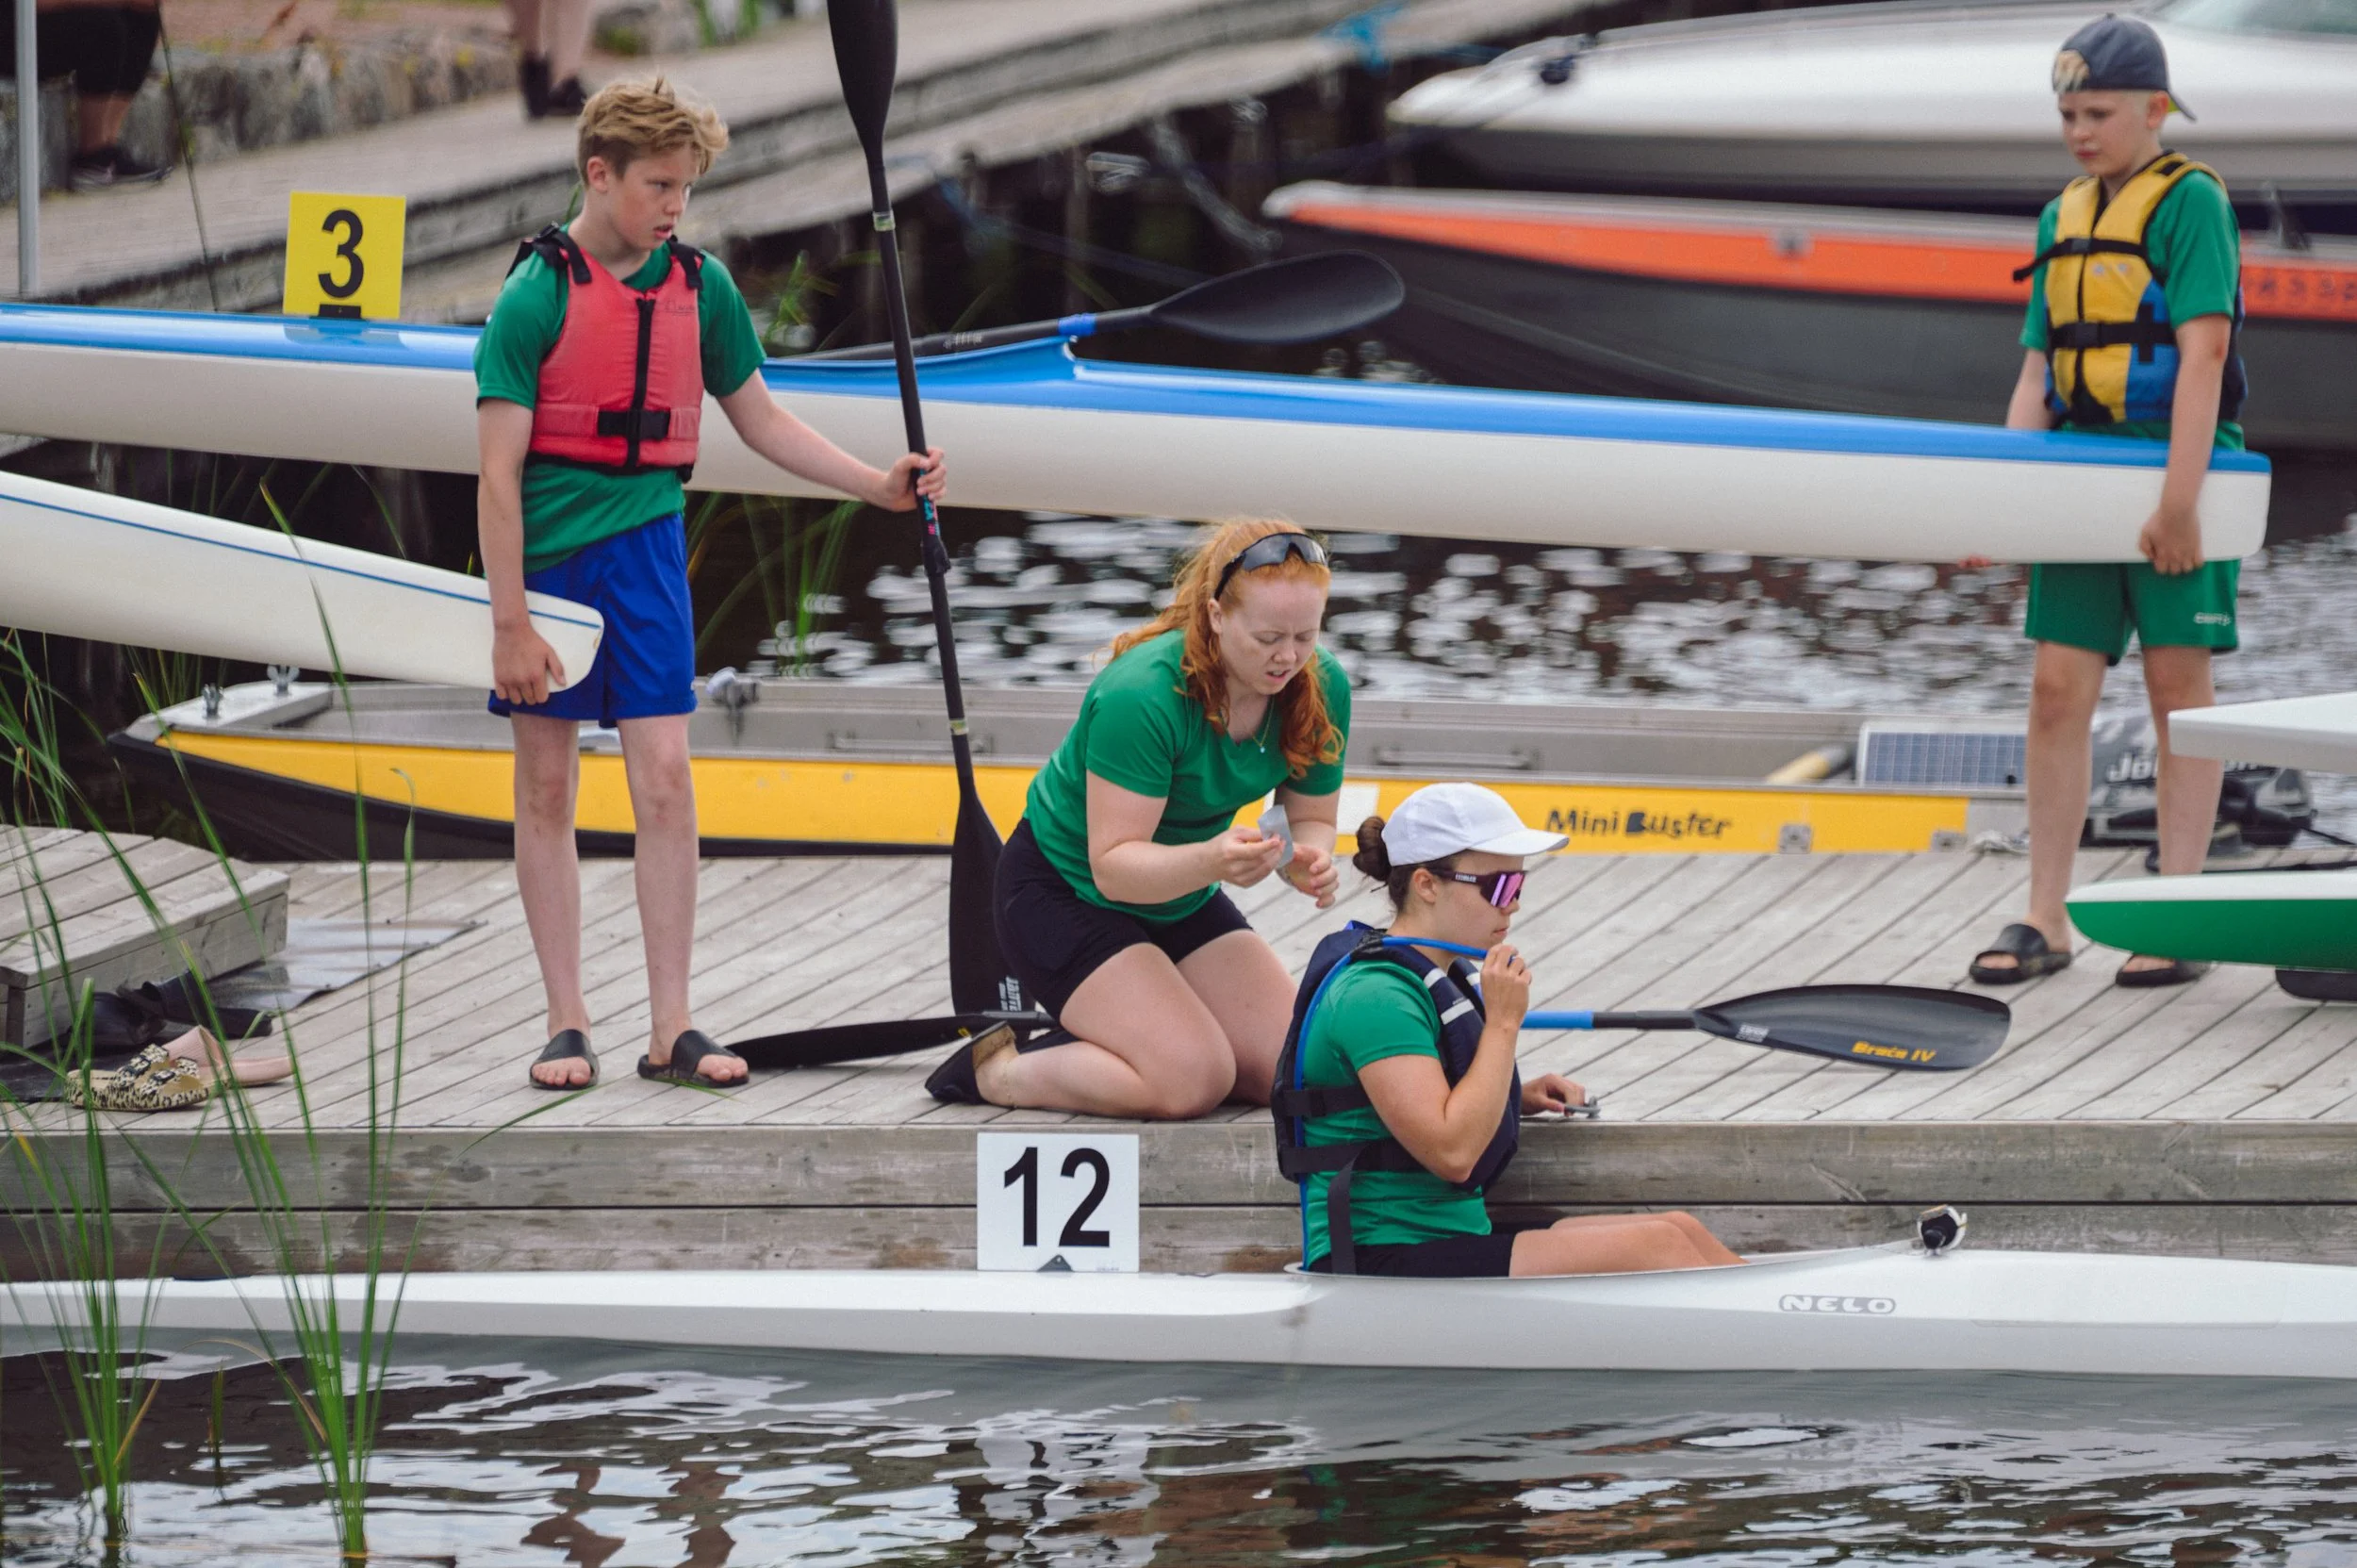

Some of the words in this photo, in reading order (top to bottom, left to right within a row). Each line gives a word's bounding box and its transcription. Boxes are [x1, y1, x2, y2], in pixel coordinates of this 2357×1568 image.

[318, 208, 364, 298] 3
[1546, 809, 1620, 834] Mini
[1625, 812, 1732, 838] Buster
[1004, 1147, 1110, 1247] 12
[1782, 1295, 1895, 1313] NELO
